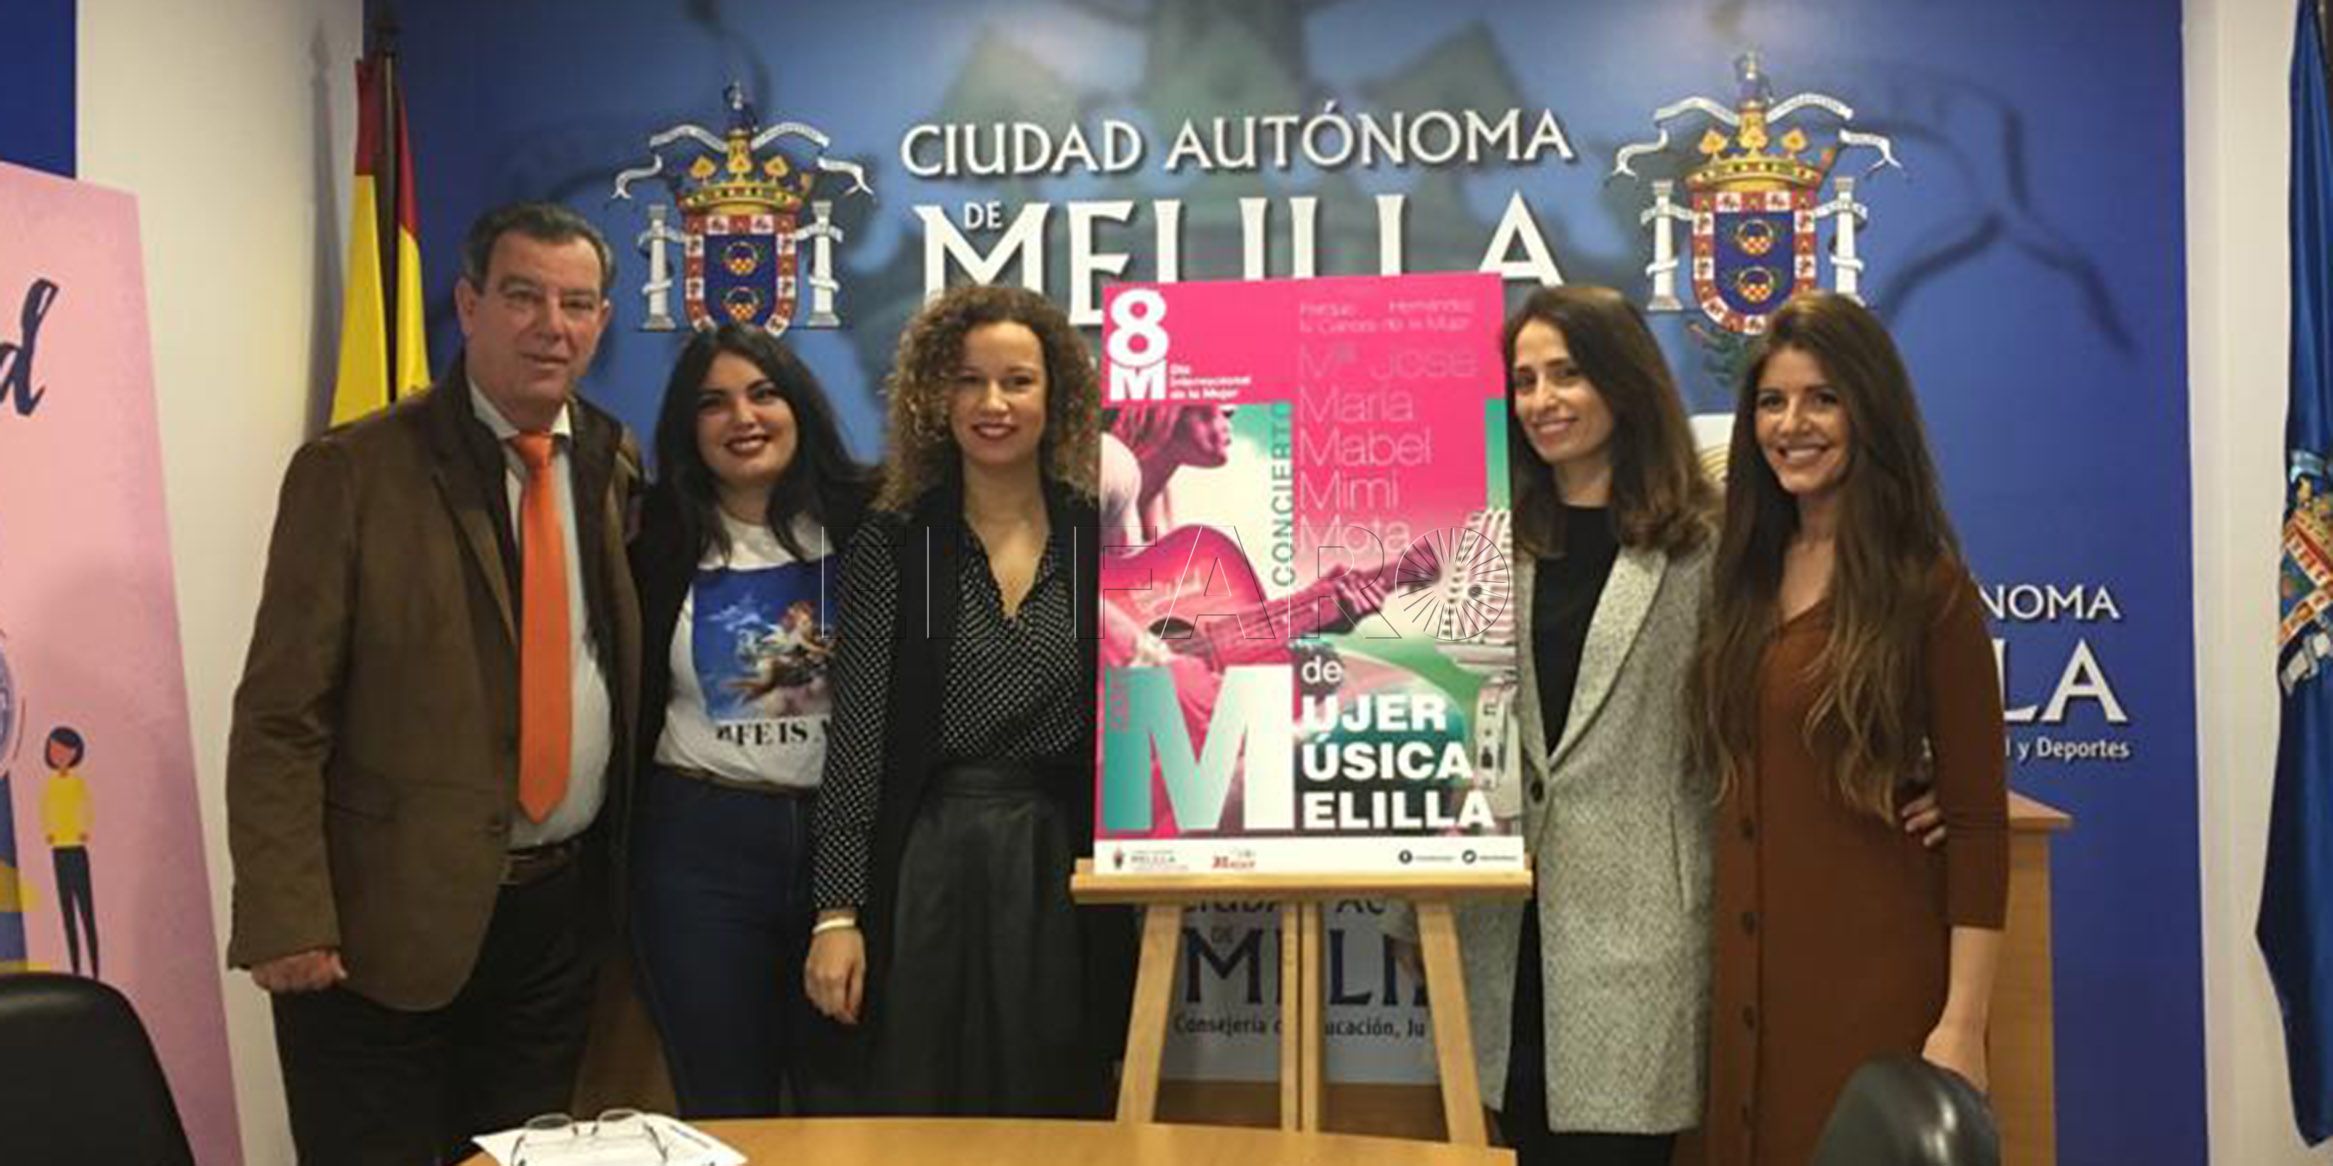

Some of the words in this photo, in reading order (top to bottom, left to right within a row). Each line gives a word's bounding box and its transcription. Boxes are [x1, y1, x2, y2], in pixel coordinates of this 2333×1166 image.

[901, 118, 1144, 176] CIUDAD
[1165, 100, 1574, 170] AUTÓNOMA
[963, 202, 1002, 230] DE
[1108, 288, 1169, 367] 8
[1299, 425, 1432, 467] Mabel
[1270, 403, 1296, 588] CONCIERTO
[1978, 584, 2121, 621] NOMA
[1303, 656, 1344, 684] de
[1303, 693, 1447, 732] UJER
[1103, 663, 1294, 831] M
[1303, 734, 1475, 781] ÚSICA
[2036, 736, 2131, 761] Deportes
[1303, 789, 1496, 830] ELILLA
[1323, 1016, 1401, 1038] ucación,
